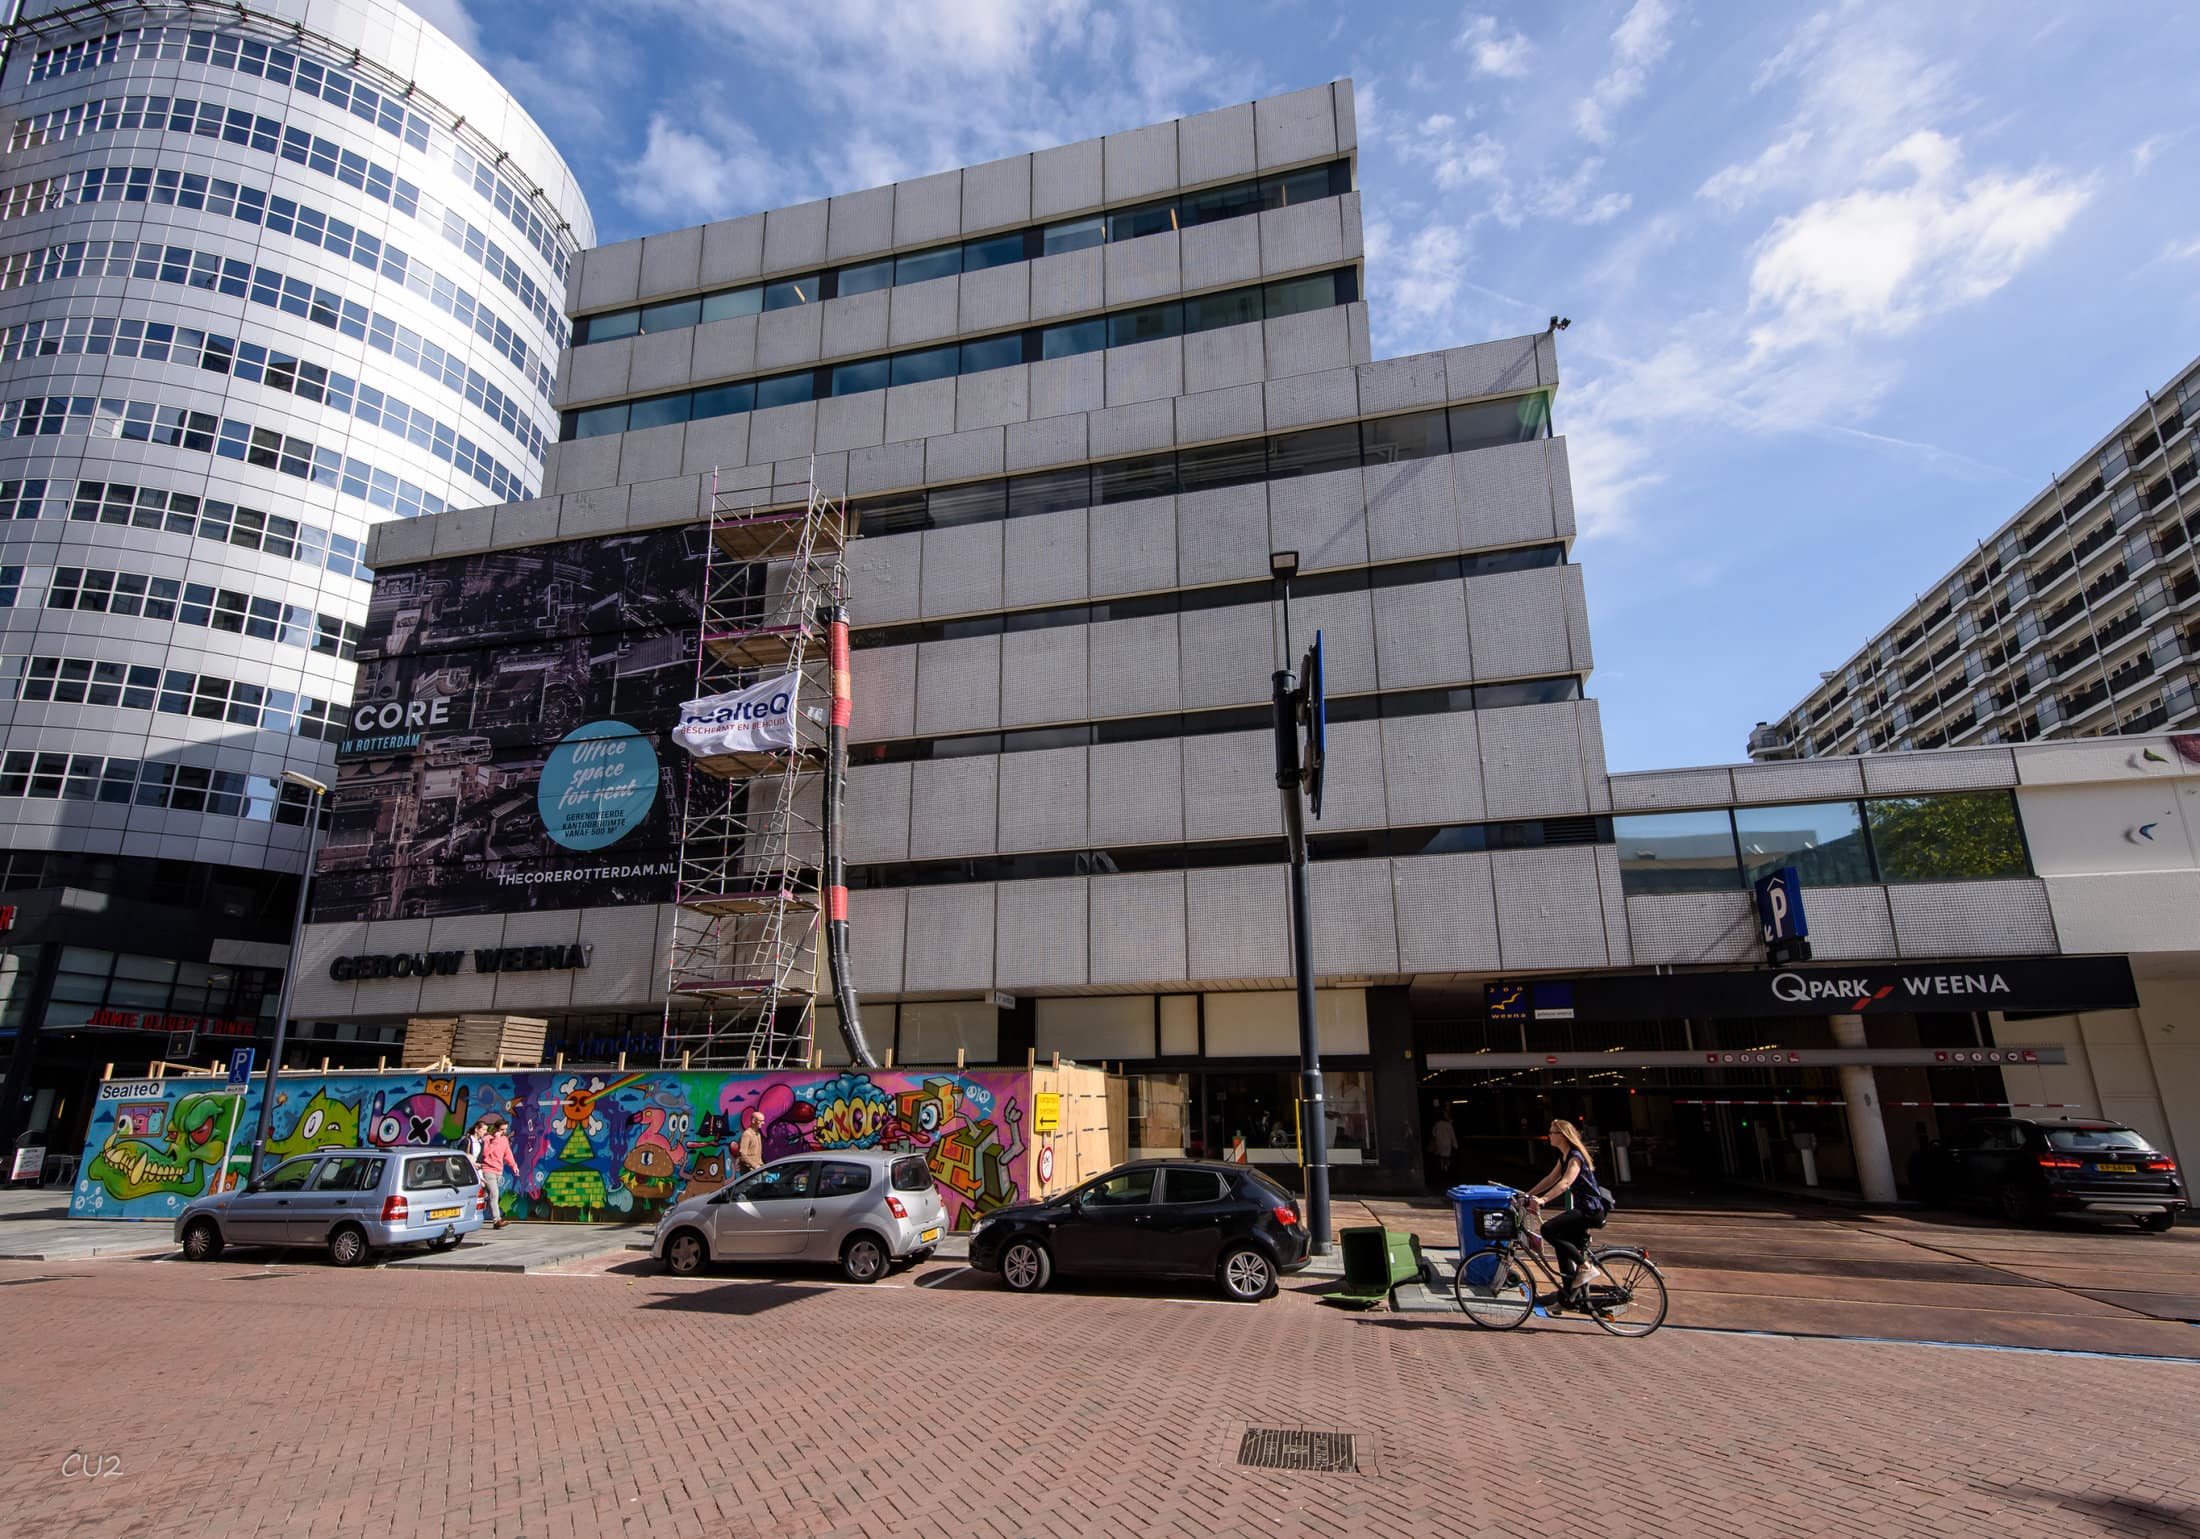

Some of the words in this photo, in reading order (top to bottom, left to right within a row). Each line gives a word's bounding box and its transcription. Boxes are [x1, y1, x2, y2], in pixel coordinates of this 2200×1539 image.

[354, 697, 450, 732] CORE
[737, 723, 750, 732] EN
[341, 739, 353, 753] IN
[355, 733, 421, 752] ROTTERDAM
[572, 738, 627, 764] Office
[570, 763, 624, 788] space
[557, 786, 590, 810] for
[592, 778, 637, 802] rent
[565, 827, 588, 838] VANAF
[591, 827, 606, 836] 500
[499, 863, 678, 886] THECOREROTTERDAM.NL
[1769, 887, 1788, 939] P
[329, 950, 465, 982] GEBOUW
[474, 943, 592, 973] WEENA
[1903, 973, 2011, 996] WEENA
[87, 1010, 139, 1028] JAMIE
[213, 1019, 254, 1036] DINER
[235, 1052, 248, 1070] P
[102, 1082, 160, 1099] SealteQ
